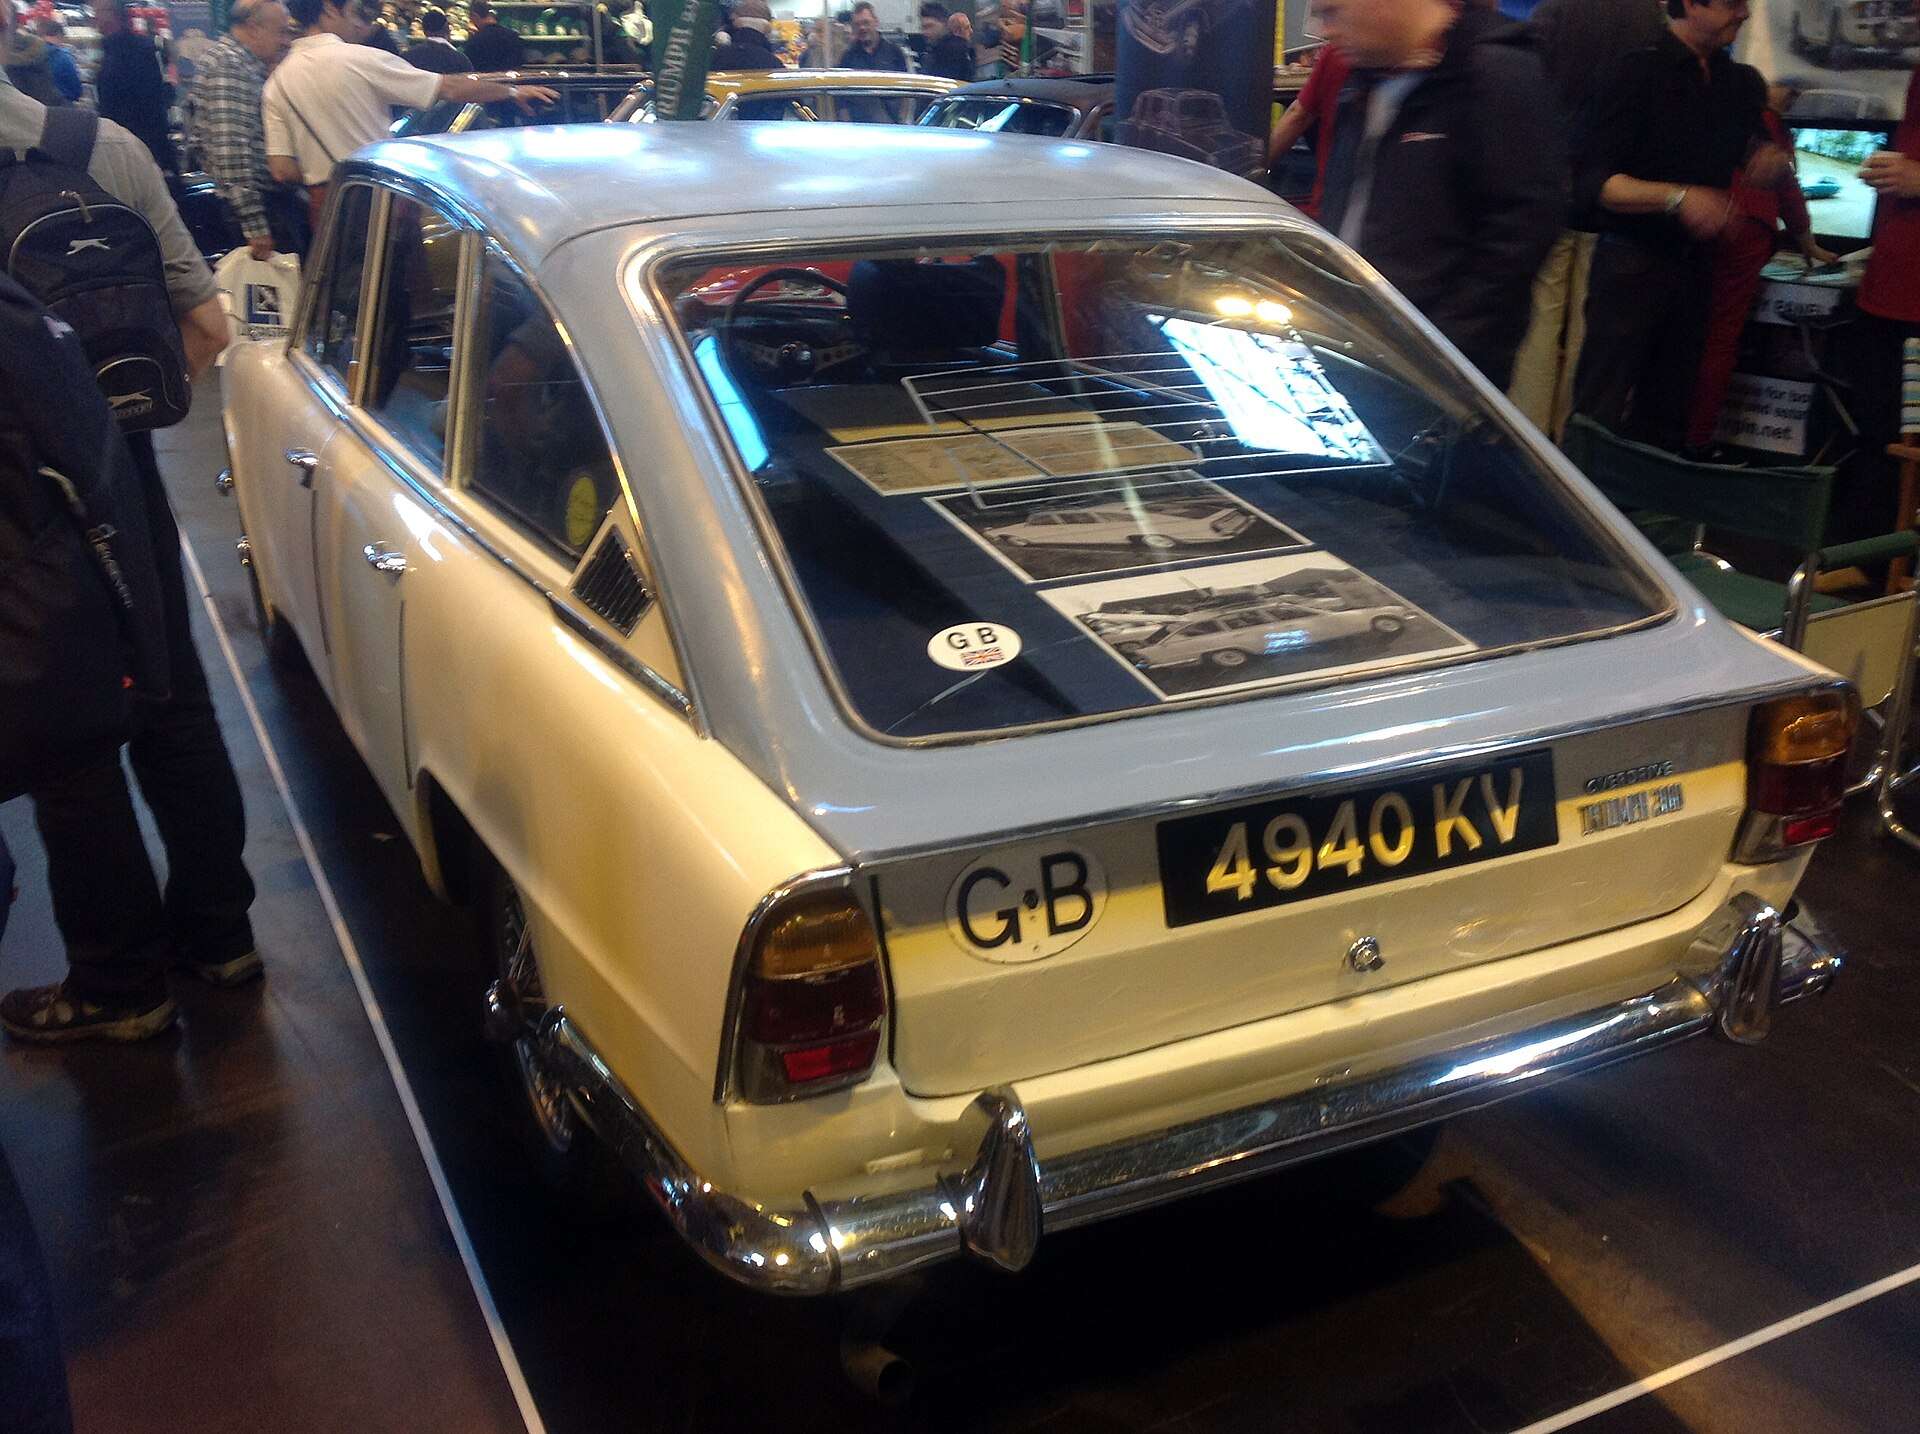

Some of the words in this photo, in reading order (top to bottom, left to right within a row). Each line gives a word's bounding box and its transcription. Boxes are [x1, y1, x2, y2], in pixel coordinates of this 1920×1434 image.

[656, 27, 692, 117] RIUMPH
[1206, 792, 1416, 901] 4940
[1433, 767, 1524, 858] KV
[957, 851, 1094, 949] GB
